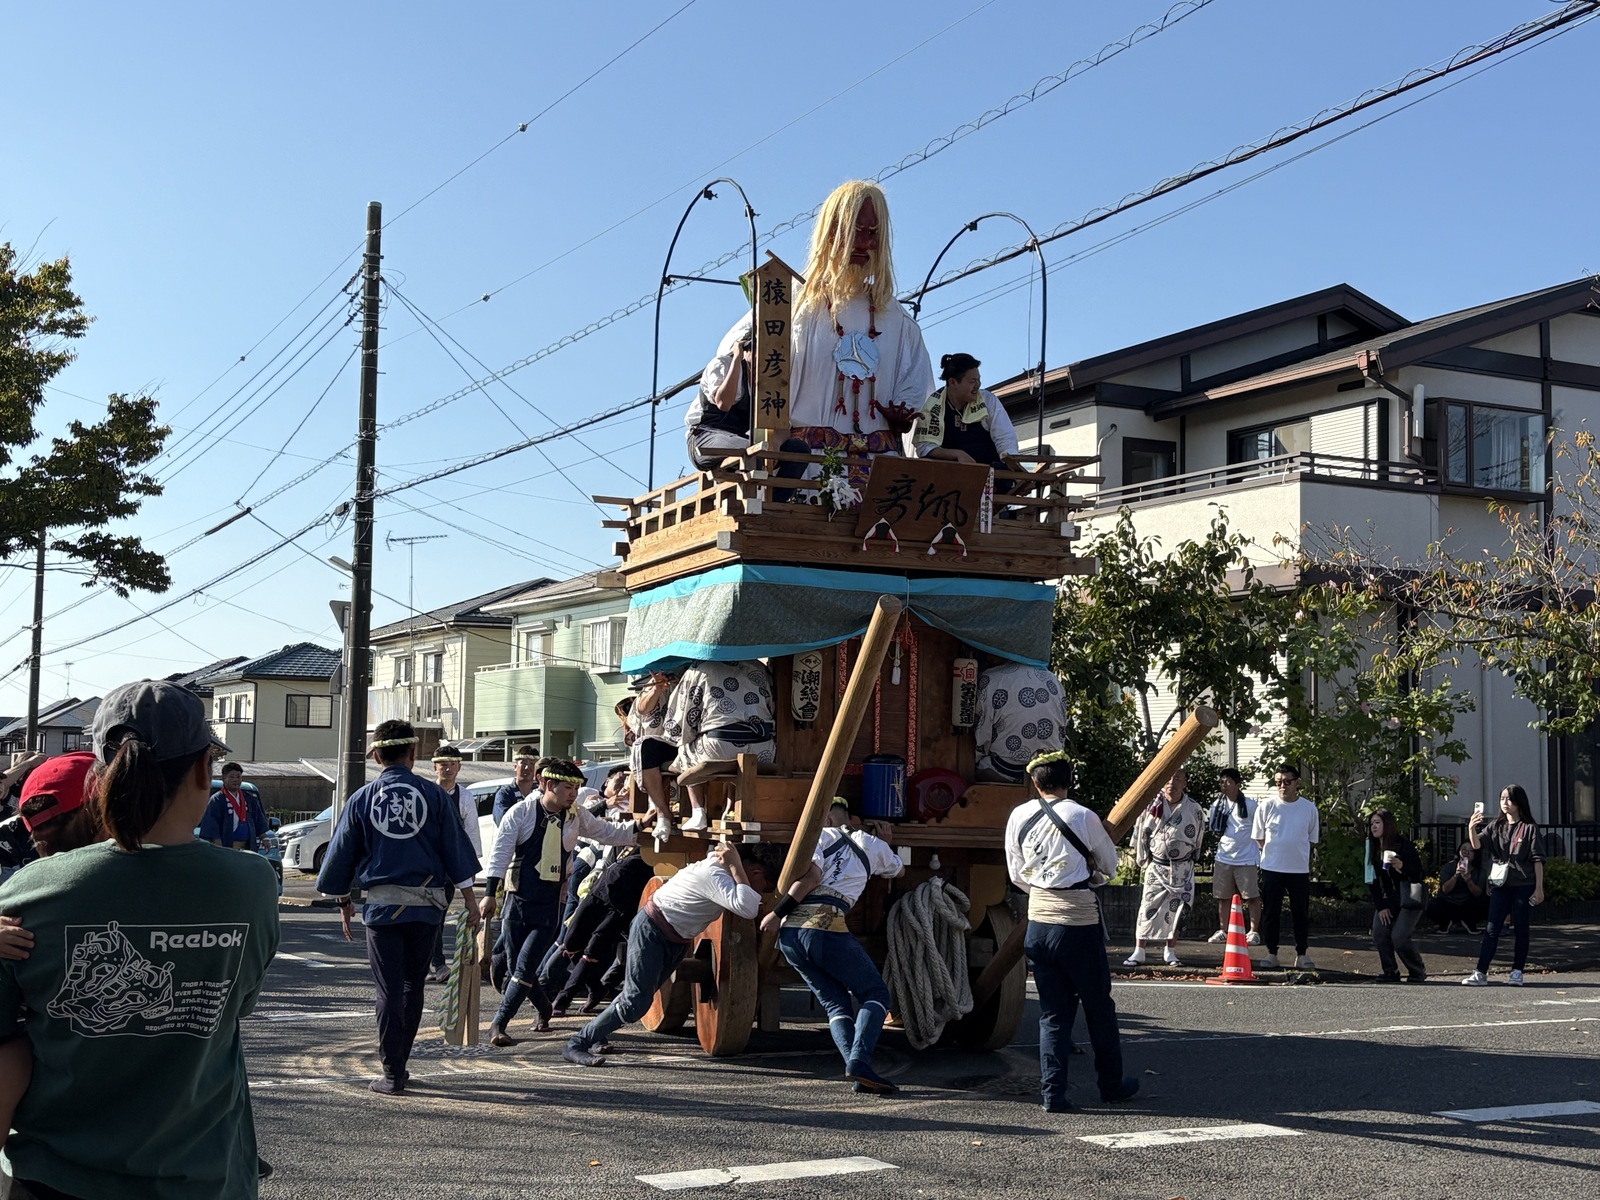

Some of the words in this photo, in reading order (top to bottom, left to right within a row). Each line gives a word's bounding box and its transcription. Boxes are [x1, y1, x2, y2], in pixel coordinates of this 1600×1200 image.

[761, 278, 789, 418] 猿田彦神
[372, 786, 424, 836] 潮
[150, 929, 243, 952] Reebok
[175, 989, 191, 997] OVER
[181, 997, 209, 1005] ATHLETIC
[145, 1022, 175, 1031] REQUIRED
